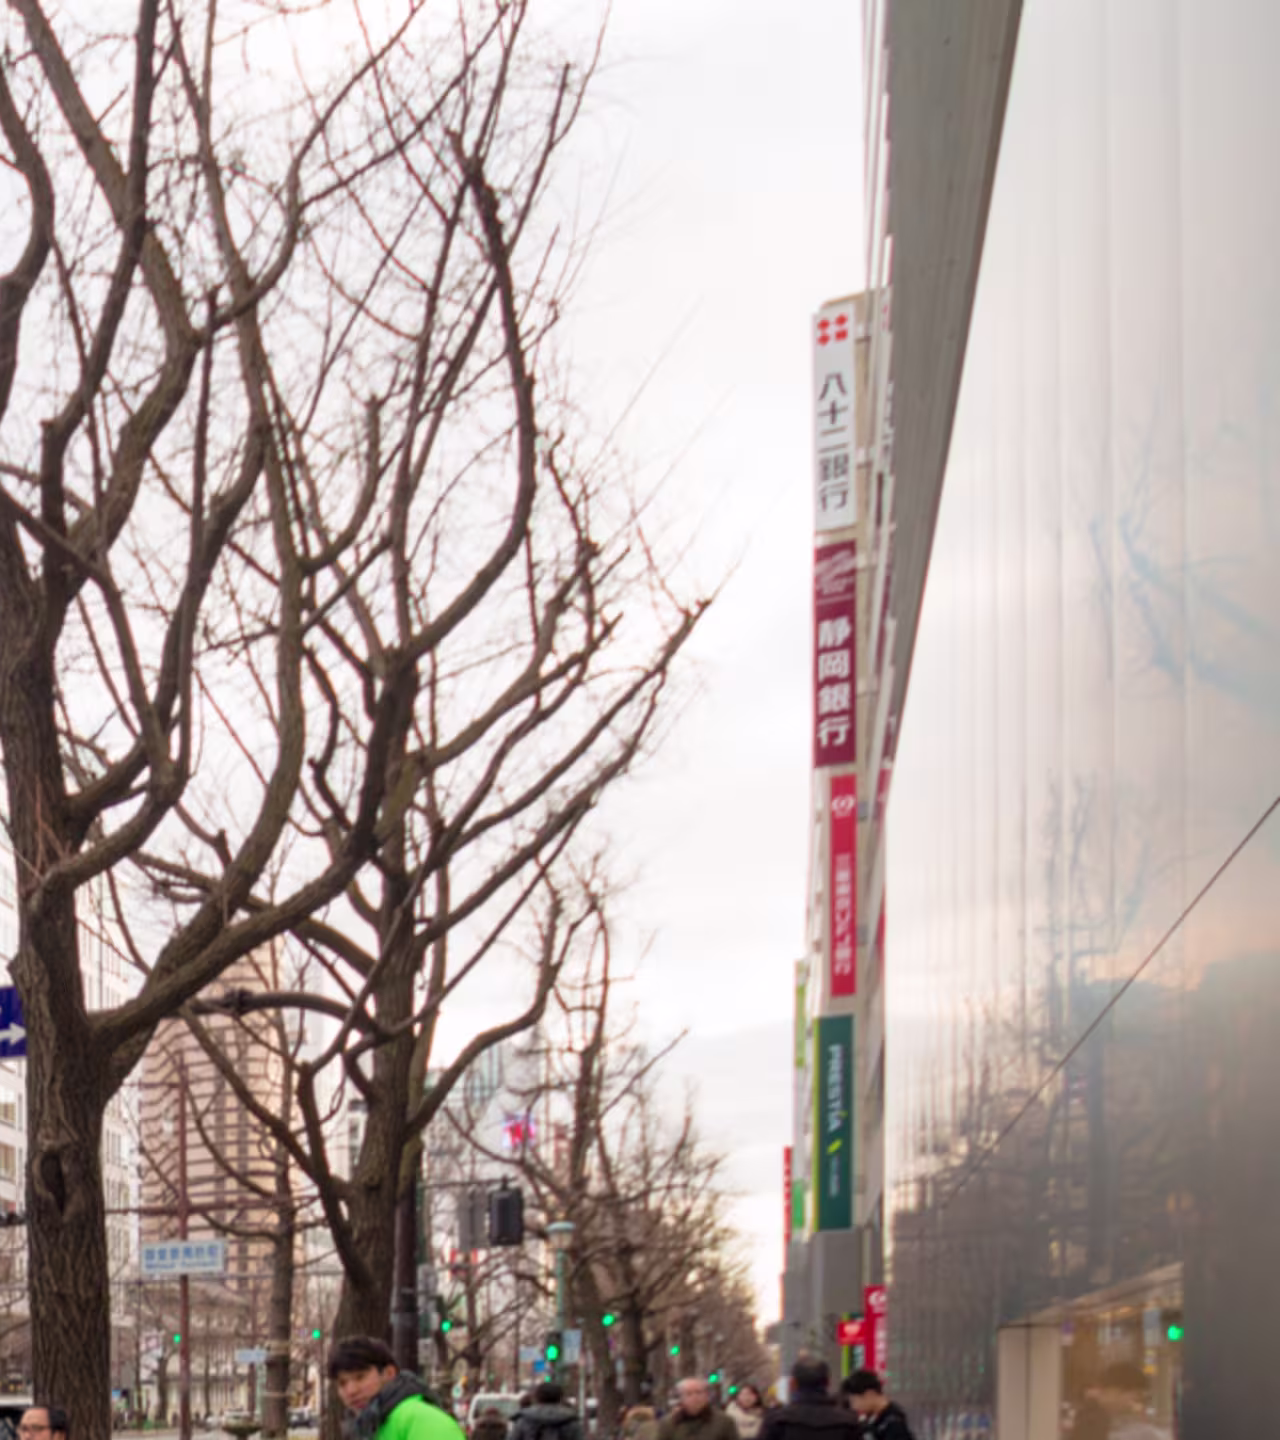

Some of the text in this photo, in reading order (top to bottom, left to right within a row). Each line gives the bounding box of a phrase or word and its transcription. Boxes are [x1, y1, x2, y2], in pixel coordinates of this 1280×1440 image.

[818, 372, 849, 511] 八十二銀行
[817, 619, 852, 746] 静岡銀行
